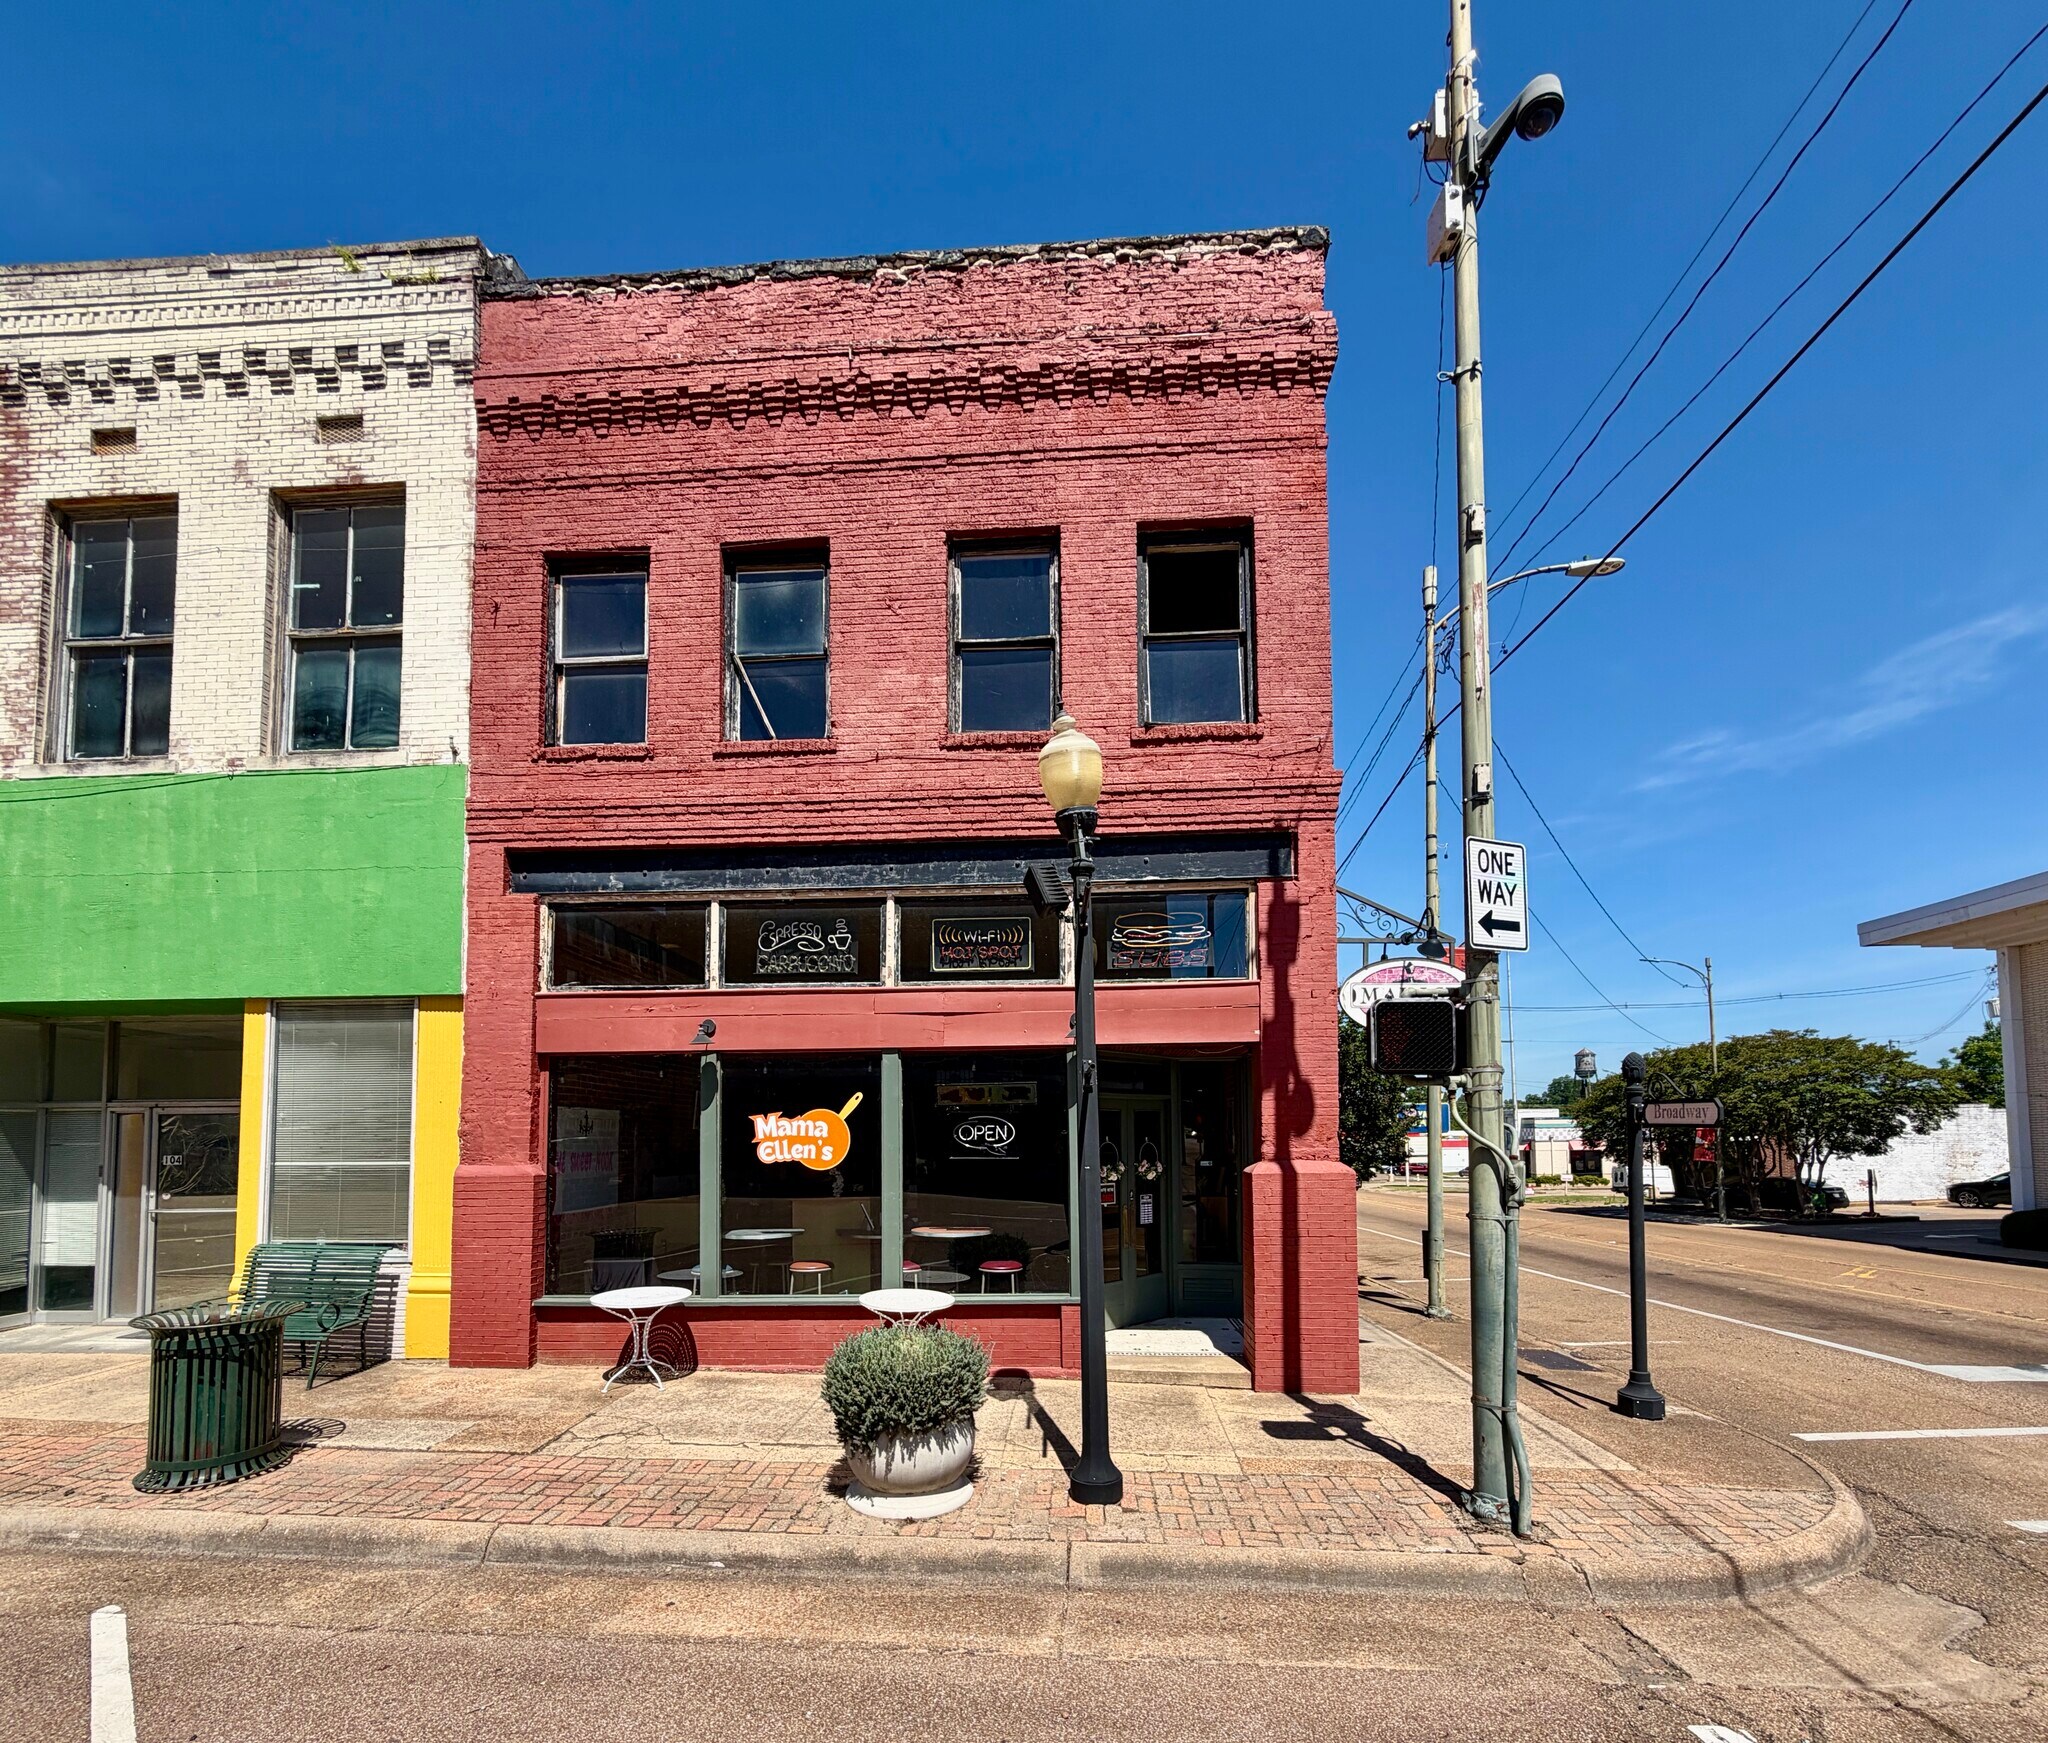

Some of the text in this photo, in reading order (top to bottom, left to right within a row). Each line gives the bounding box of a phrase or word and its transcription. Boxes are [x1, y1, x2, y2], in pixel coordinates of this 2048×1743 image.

[1478, 848, 1515, 876] ONE
[1478, 878, 1517, 906] WAY
[758, 920, 822, 951] ESPRESSO
[963, 929, 1000, 943] Wi-Fi
[940, 945, 1021, 959] HOT SPOT
[1113, 948, 1208, 966] SUBS
[758, 954, 856, 973] CAPPUCCINO
[1654, 1104, 1710, 1120] Broadway
[755, 1115, 828, 1139] Mama
[959, 1124, 1008, 1141] OPEN
[760, 1140, 834, 1161] Ellen's
[164, 1155, 181, 1165] 104
